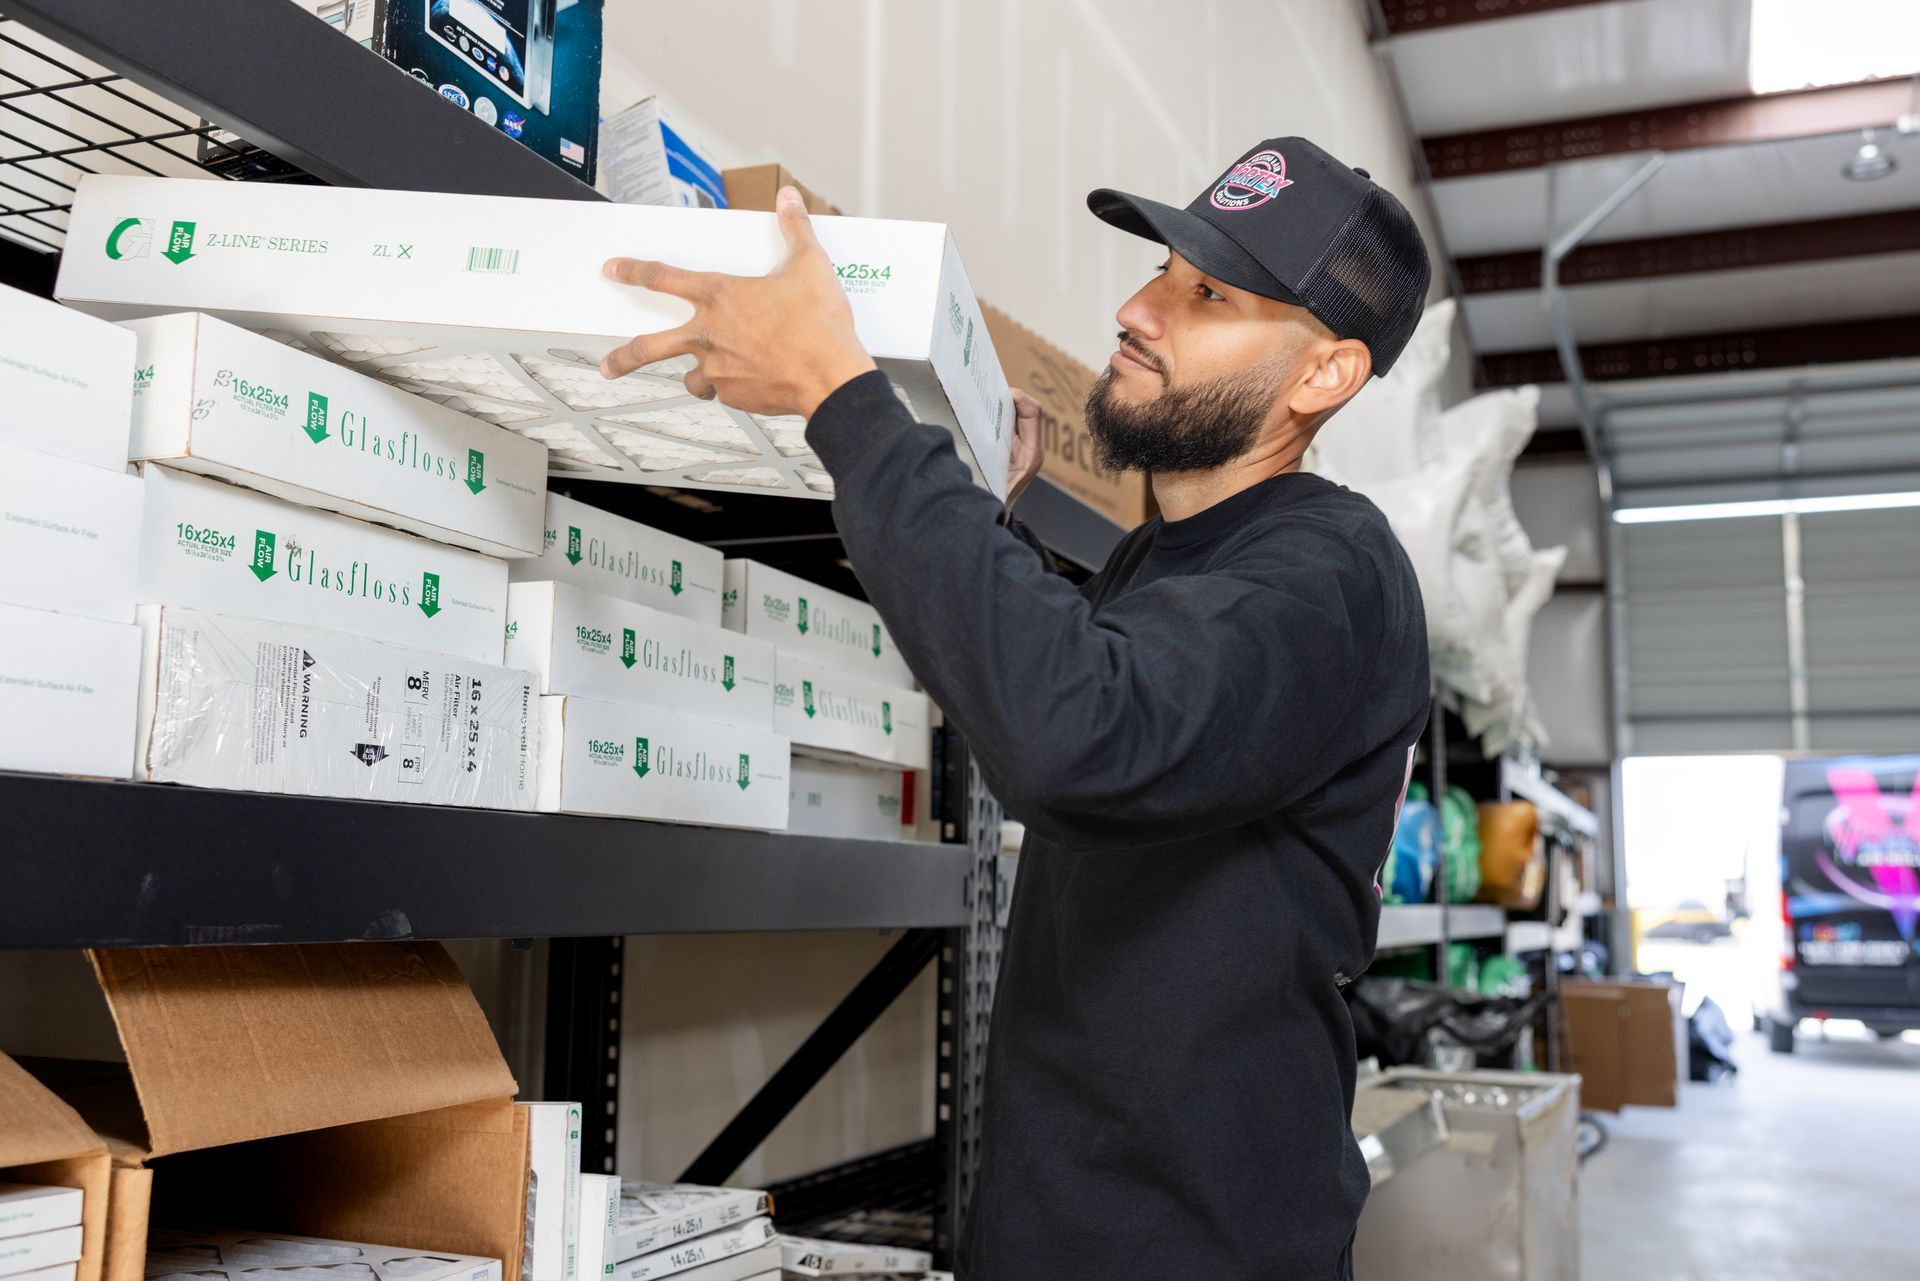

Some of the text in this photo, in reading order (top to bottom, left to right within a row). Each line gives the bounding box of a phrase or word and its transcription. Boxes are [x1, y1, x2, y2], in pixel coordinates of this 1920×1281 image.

[504, 118, 522, 131] NASA
[1217, 164, 1294, 199] VORTEX
[1216, 190, 1249, 207] SOLUTIONS
[172, 226, 184, 254] FLOW
[181, 232, 192, 249] AIR
[267, 236, 329, 254] SERIES
[372, 244, 392, 257] ZL
[832, 263, 893, 281] x25x4
[232, 377, 289, 410] 16x25x4
[232, 393, 287, 417] ACTUAL FILTER SIZE
[310, 399, 320, 430] FLOW
[317, 407, 325, 426] AIR
[341, 411, 456, 481] Glasfloss
[177, 522, 235, 550] 16x25x4
[177, 539, 232, 557] ACTUAL FILTER SIZE
[257, 537, 266, 569] FLOW
[264, 545, 272, 563] AIR
[589, 537, 664, 586] Glasfloss
[288, 547, 409, 606] Glasfloss
[576, 625, 612, 646] 16x25x4
[643, 638, 717, 684] Glasfloss
[407, 676, 422, 690] 8
[421, 670, 430, 700] MERV
[300, 673, 311, 738] WARNING
[452, 690, 460, 718] Filter
[466, 678, 482, 773] 16 x 25 x 4
[518, 685, 530, 791] Honeywell Home
[588, 739, 624, 756] 16x25x4
[402, 758, 414, 769] 8
[657, 745, 733, 784] Glasfloss
